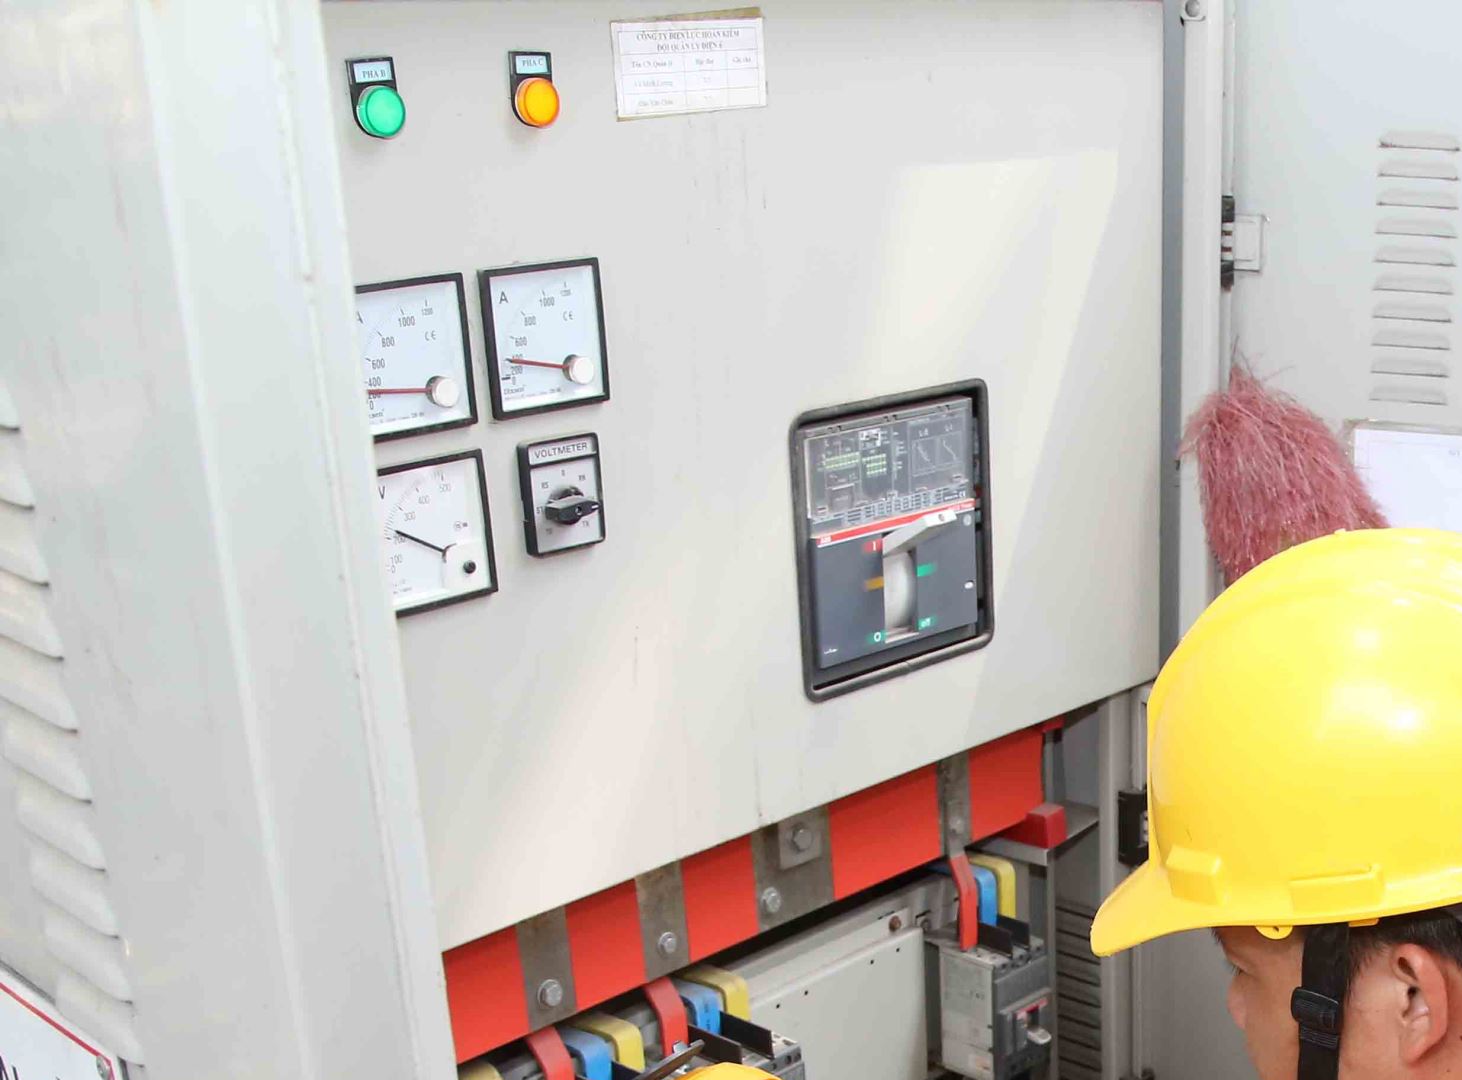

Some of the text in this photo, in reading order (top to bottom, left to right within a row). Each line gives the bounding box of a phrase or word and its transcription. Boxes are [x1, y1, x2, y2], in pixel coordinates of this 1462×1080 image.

[522, 57, 545, 67] PHA C
[362, 68, 387, 79] PHA B
[499, 291, 509, 304] A
[398, 315, 416, 327] 1000
[381, 336, 395, 348] 800
[515, 336, 528, 347] 600
[371, 358, 386, 370] 600
[510, 365, 523, 376] 200
[367, 376, 382, 388] 400
[369, 400, 375, 411] 0
[534, 442, 588, 459] VOLTMETER
[378, 486, 386, 500] V
[403, 511, 416, 522] 300
